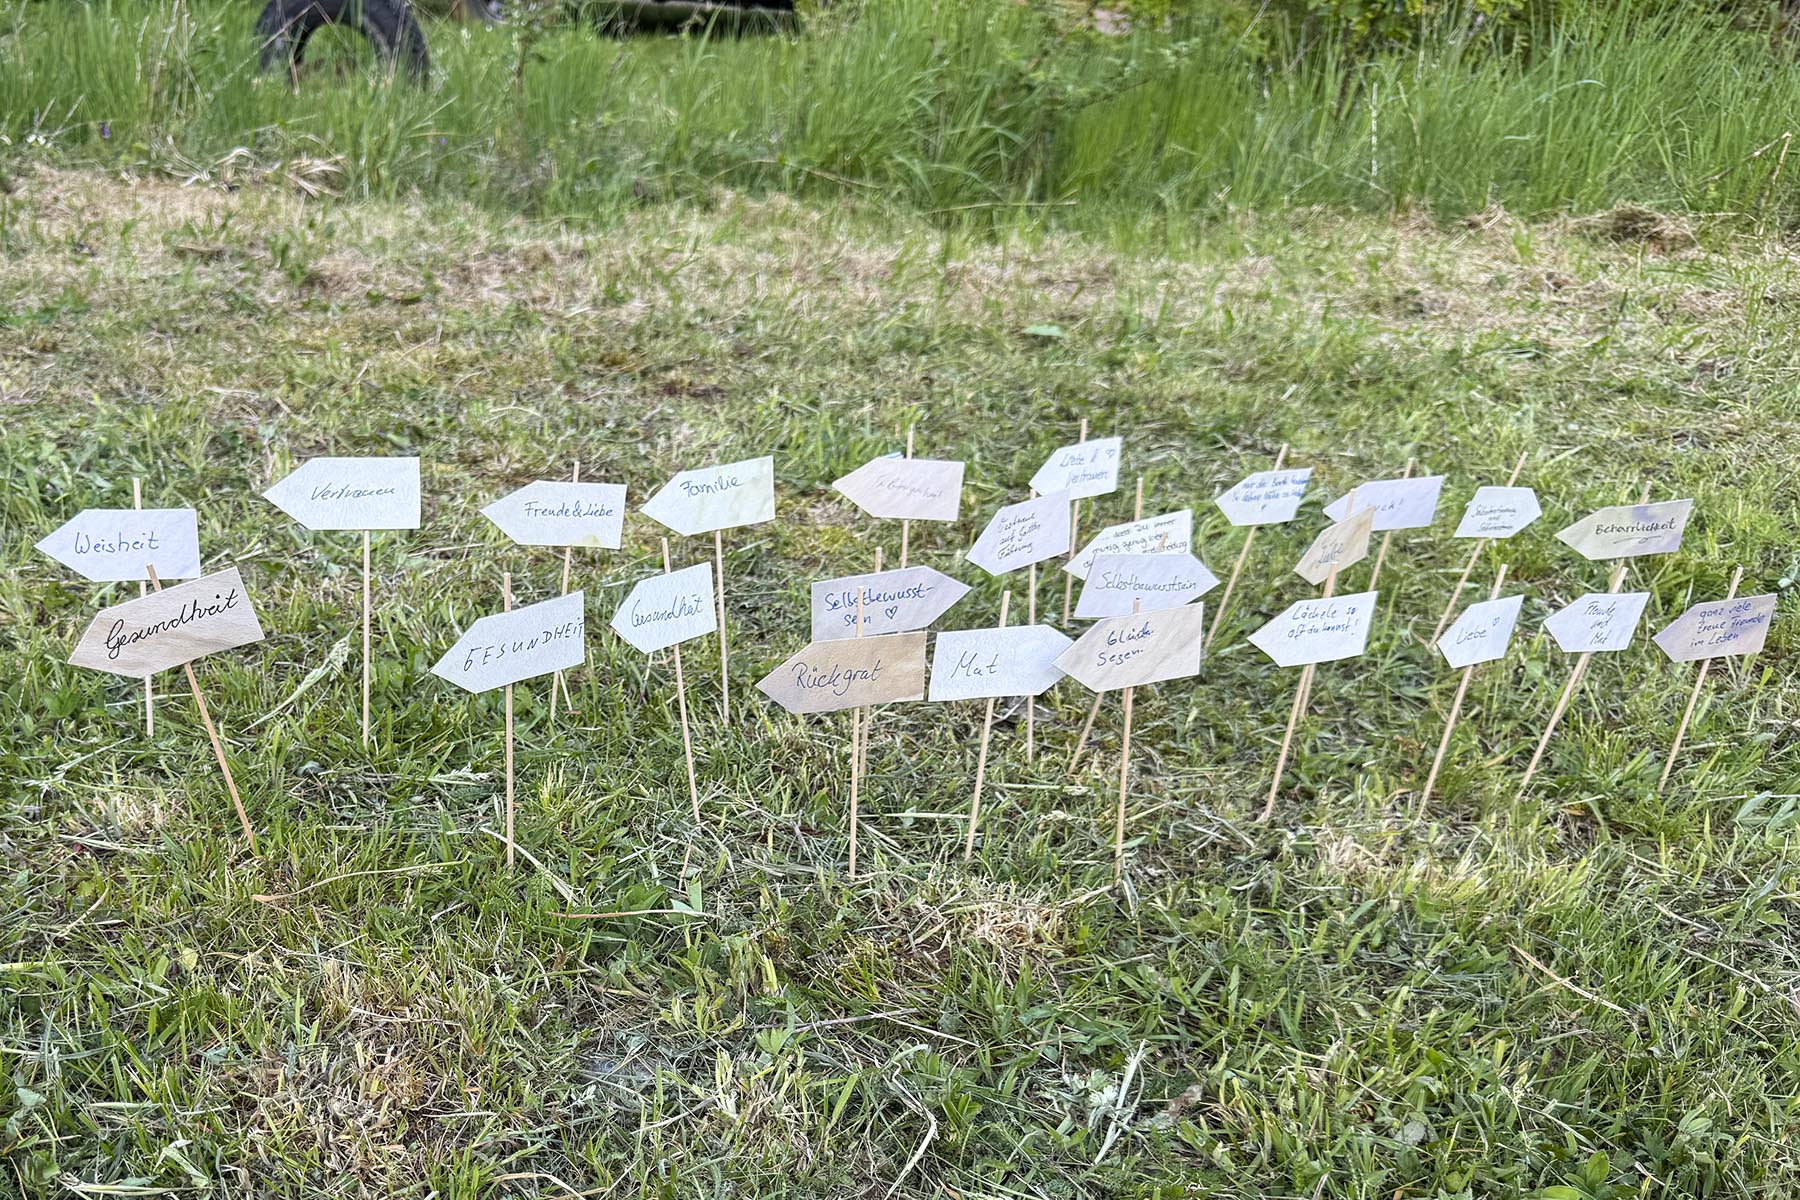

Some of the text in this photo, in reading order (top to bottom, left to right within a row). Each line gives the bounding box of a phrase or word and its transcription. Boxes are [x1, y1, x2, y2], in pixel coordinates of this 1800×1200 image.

[311, 482, 396, 500] Vertrauen
[680, 476, 744, 499] Familie
[74, 530, 160, 554] Weisheit
[103, 588, 239, 661] Gesundheit
[843, 613, 873, 627] sen
[950, 650, 999, 679] Mut
[791, 660, 882, 696] Rückgrat
